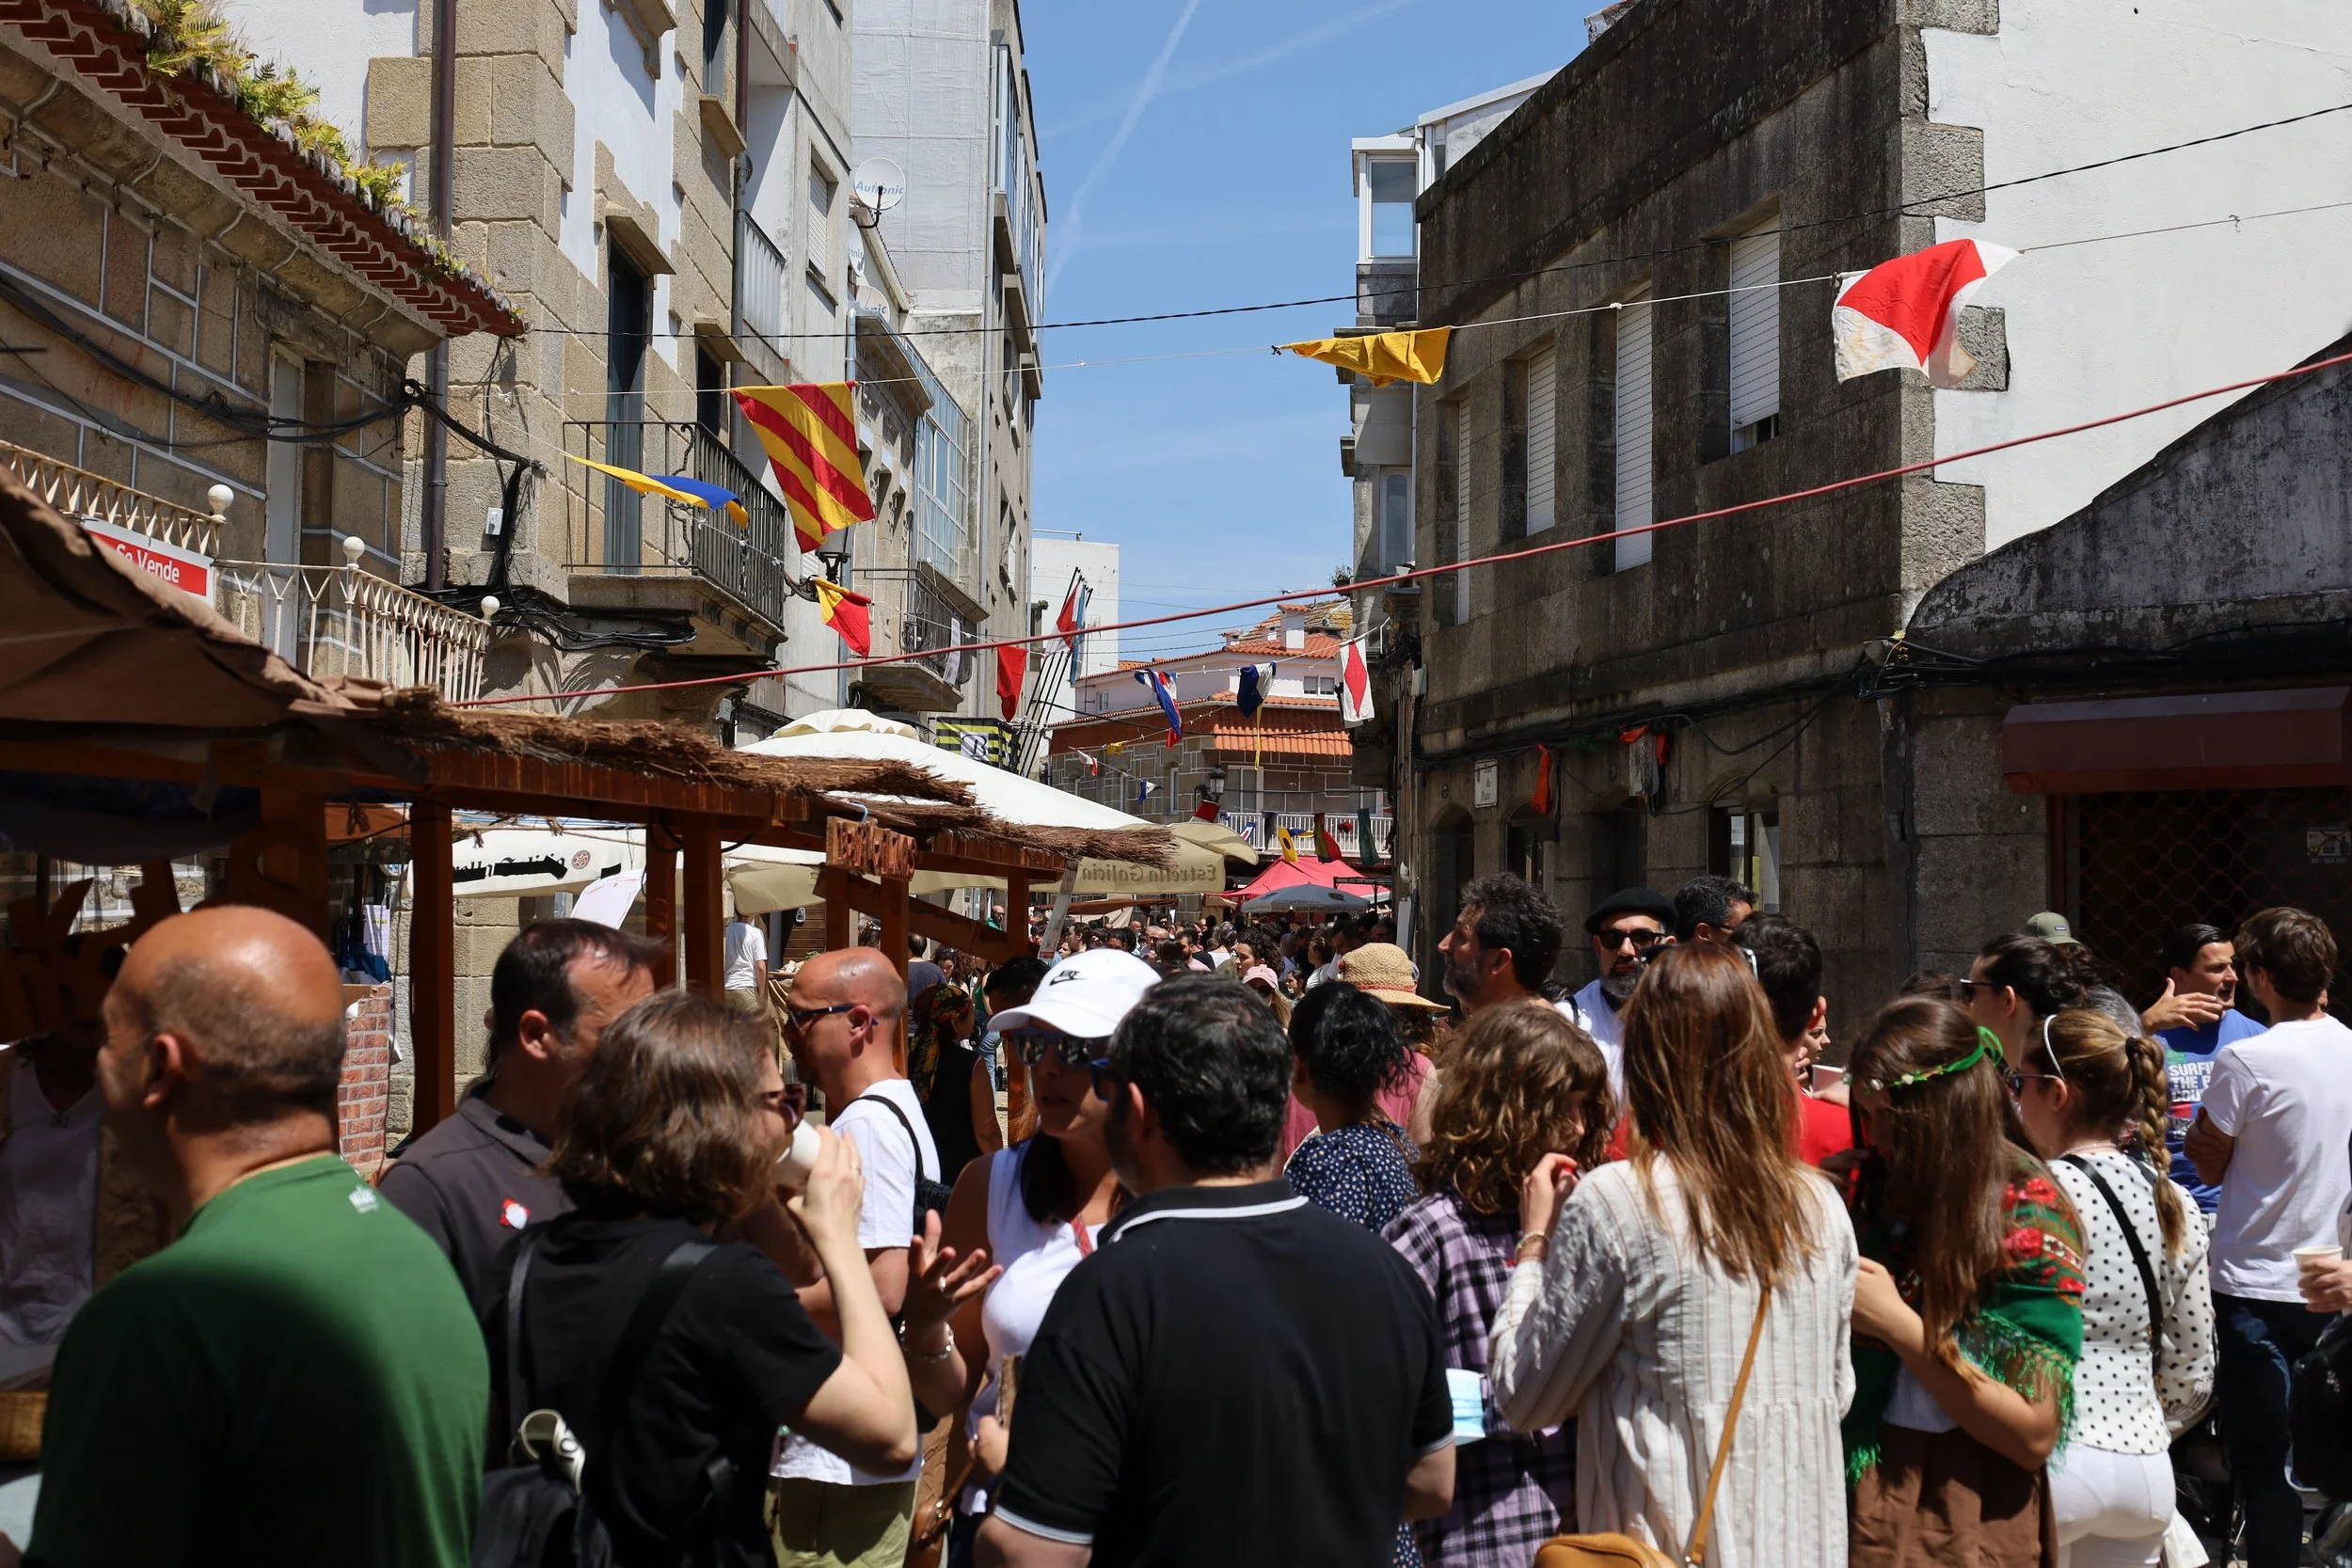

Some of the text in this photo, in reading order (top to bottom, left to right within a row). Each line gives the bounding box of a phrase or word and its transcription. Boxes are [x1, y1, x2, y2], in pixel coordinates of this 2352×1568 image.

[136, 549, 181, 583] Vende
[2170, 1075, 2199, 1090] THE
[2171, 1089, 2202, 1102] COU
